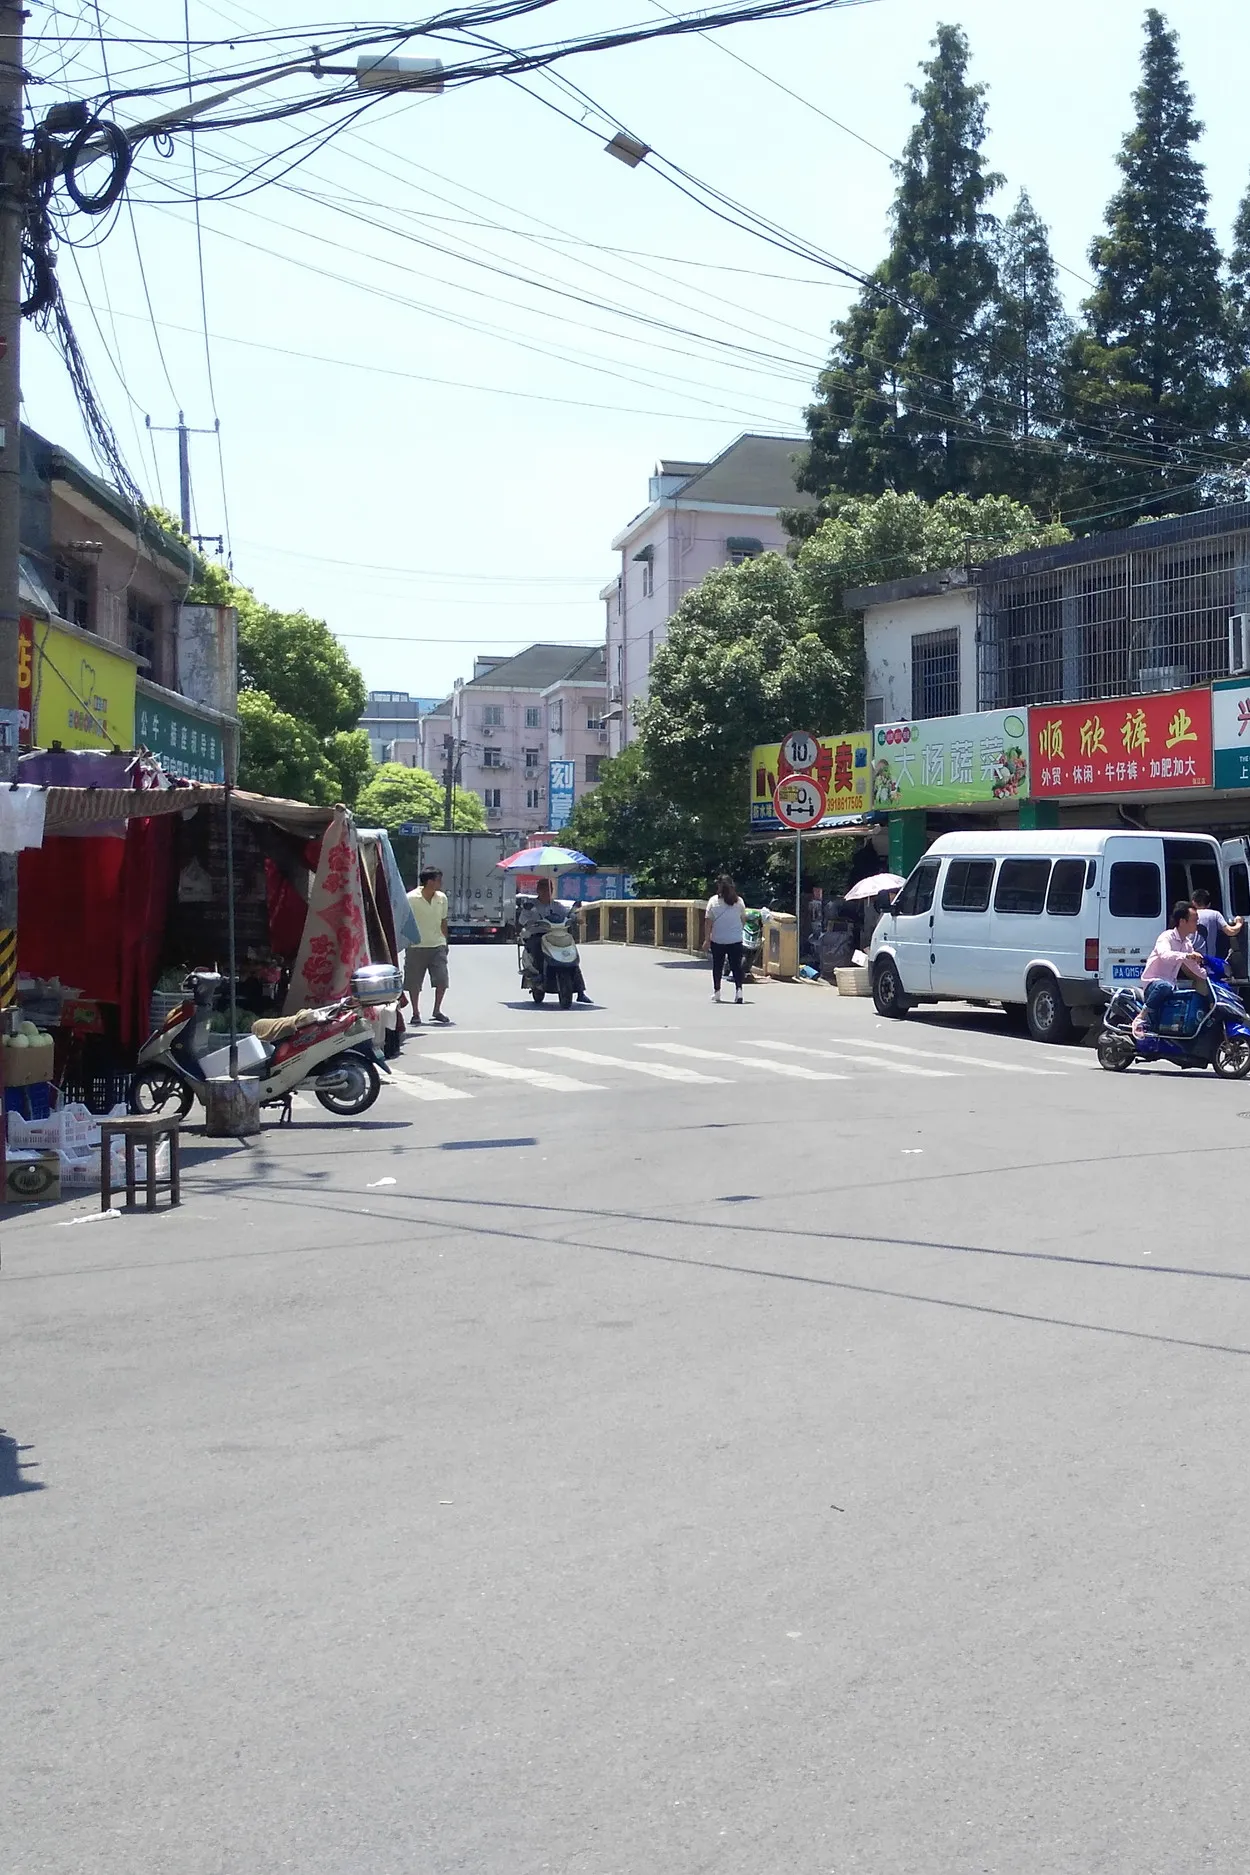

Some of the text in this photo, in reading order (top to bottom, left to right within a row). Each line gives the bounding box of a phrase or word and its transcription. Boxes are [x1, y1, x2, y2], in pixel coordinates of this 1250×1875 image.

[1039, 708, 1198, 761] 顺欣裤业
[894, 736, 1004, 788] 大杨蔬菜
[827, 796, 862, 812] 3918617505
